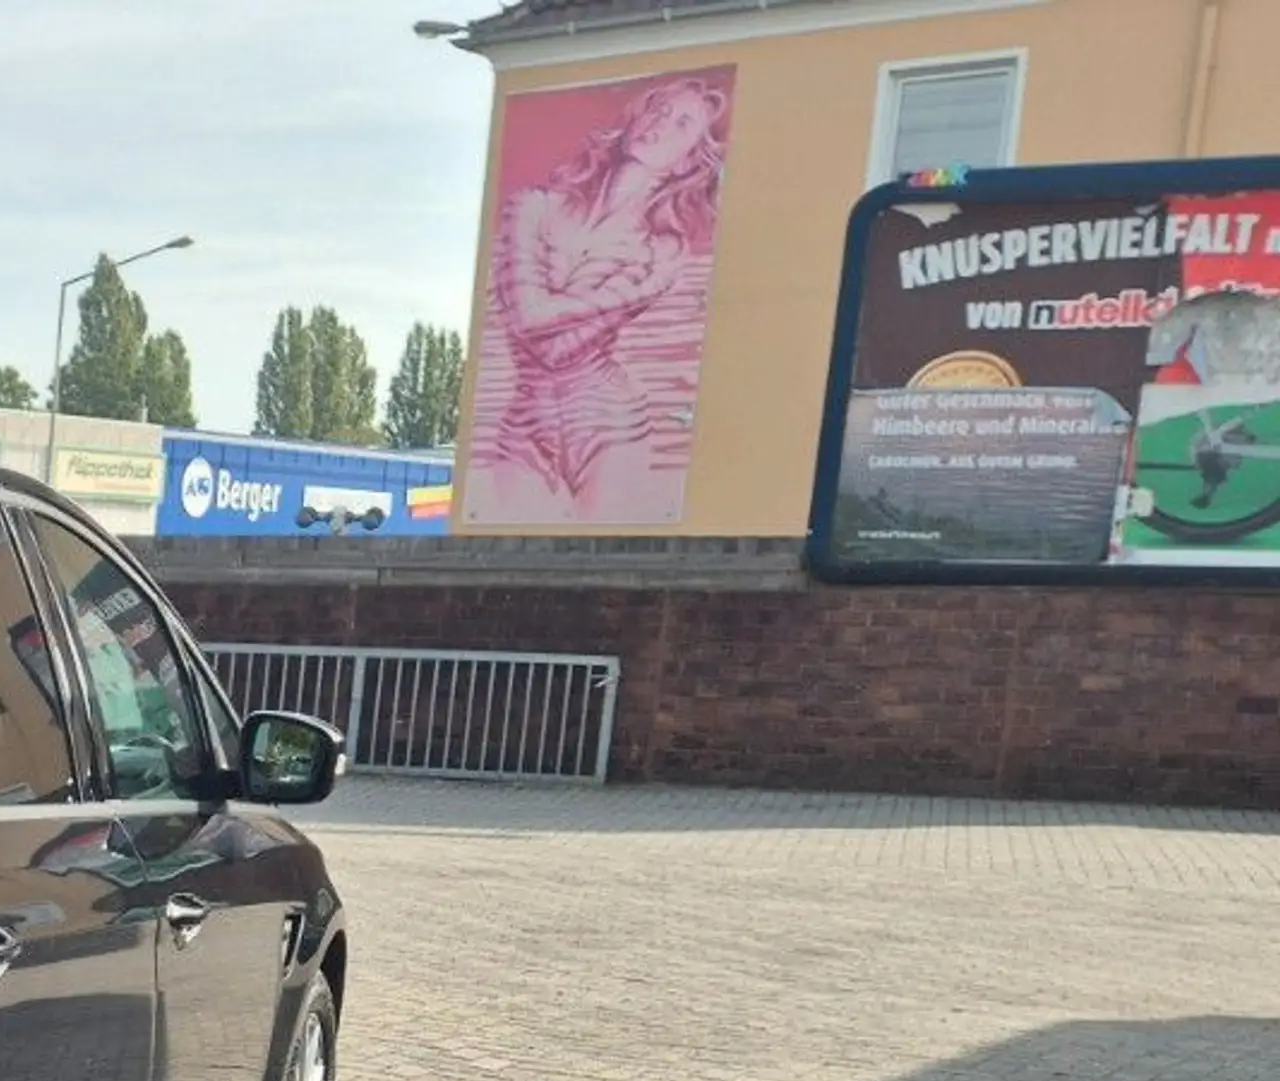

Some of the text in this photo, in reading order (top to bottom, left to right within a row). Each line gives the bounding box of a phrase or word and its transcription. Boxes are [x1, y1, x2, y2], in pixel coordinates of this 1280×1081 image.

[898, 213, 1261, 289] KNUSPERVIELFALT
[966, 301, 1022, 329] von
[872, 416, 970, 436] Himbeere
[217, 468, 282, 522] Berger
